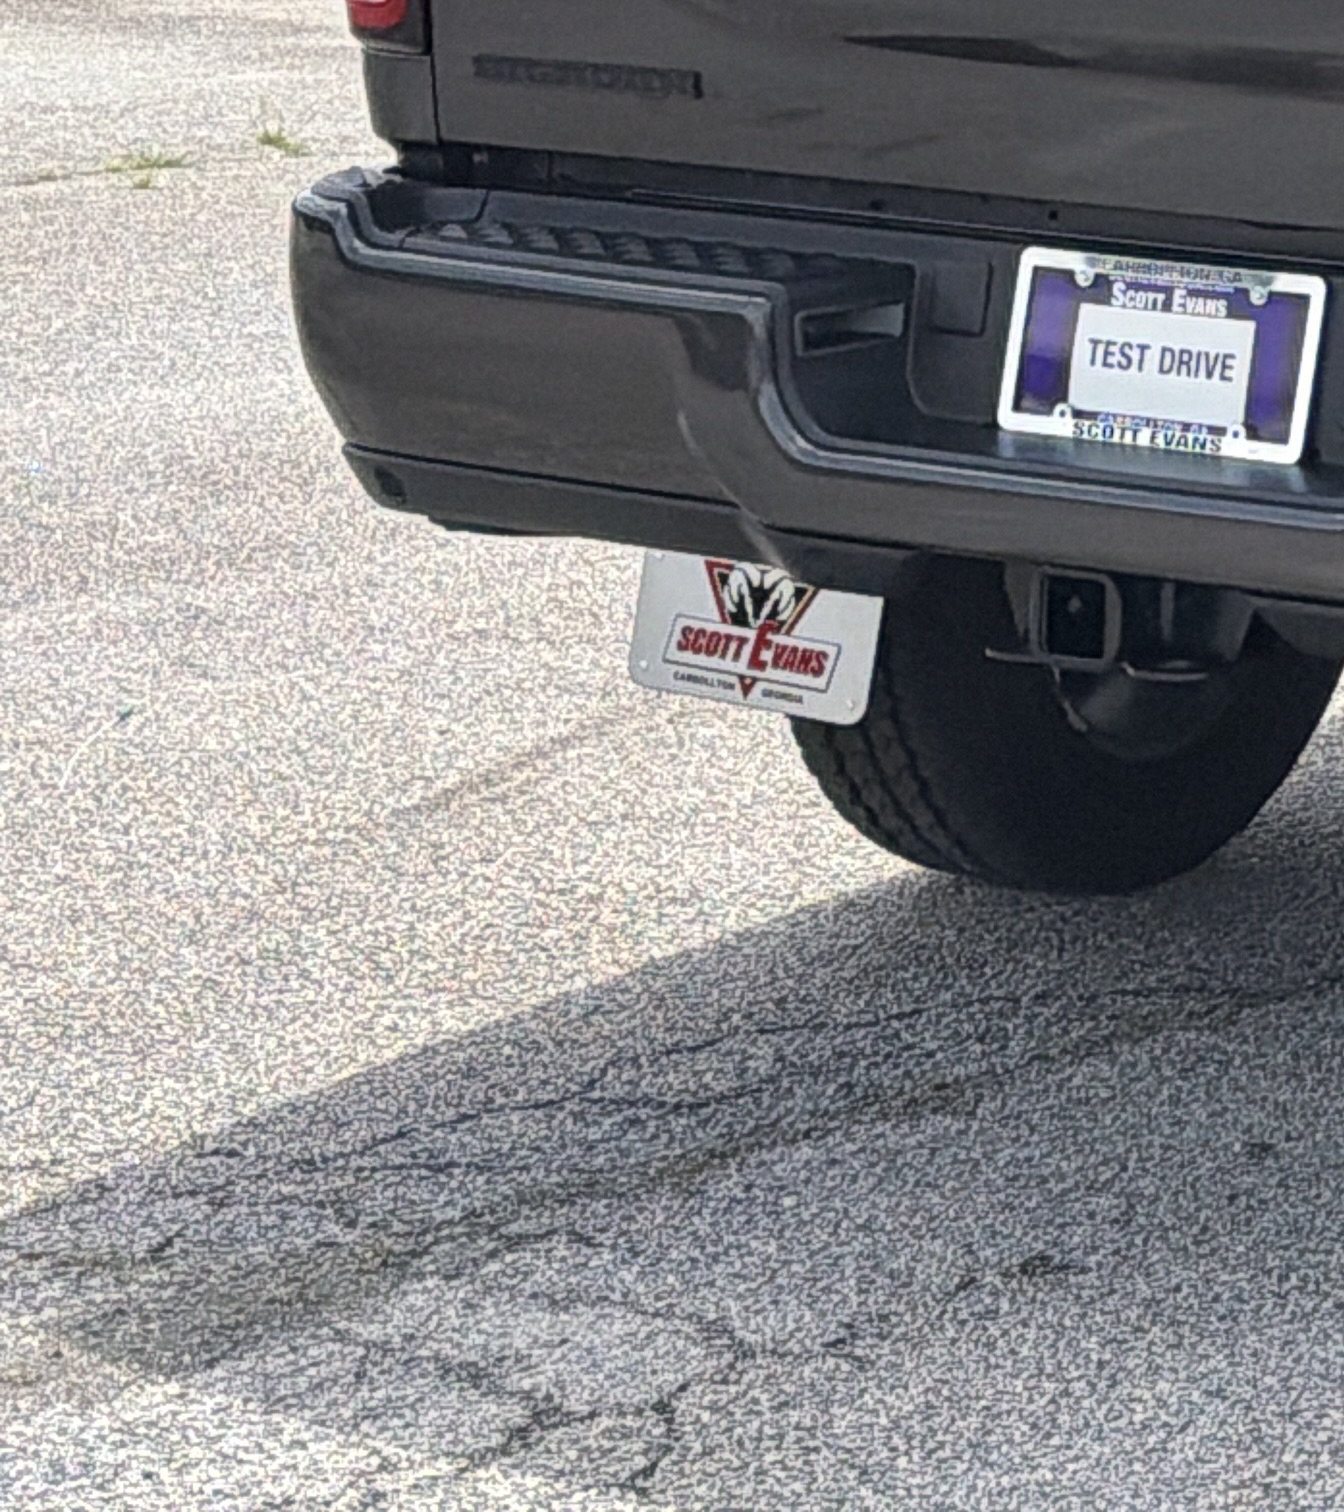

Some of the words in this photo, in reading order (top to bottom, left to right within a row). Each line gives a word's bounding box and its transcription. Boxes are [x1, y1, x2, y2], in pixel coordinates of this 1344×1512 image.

[1111, 281, 1166, 308] SCOTT
[1172, 288, 1228, 317] EVANS
[1088, 338, 1151, 374] TEST
[1158, 346, 1237, 383] DRIVE
[1072, 420, 1142, 446] SCOTT
[1151, 429, 1222, 453] EVANS
[676, 624, 750, 664] SCOTT
[746, 619, 830, 679] EVANS
